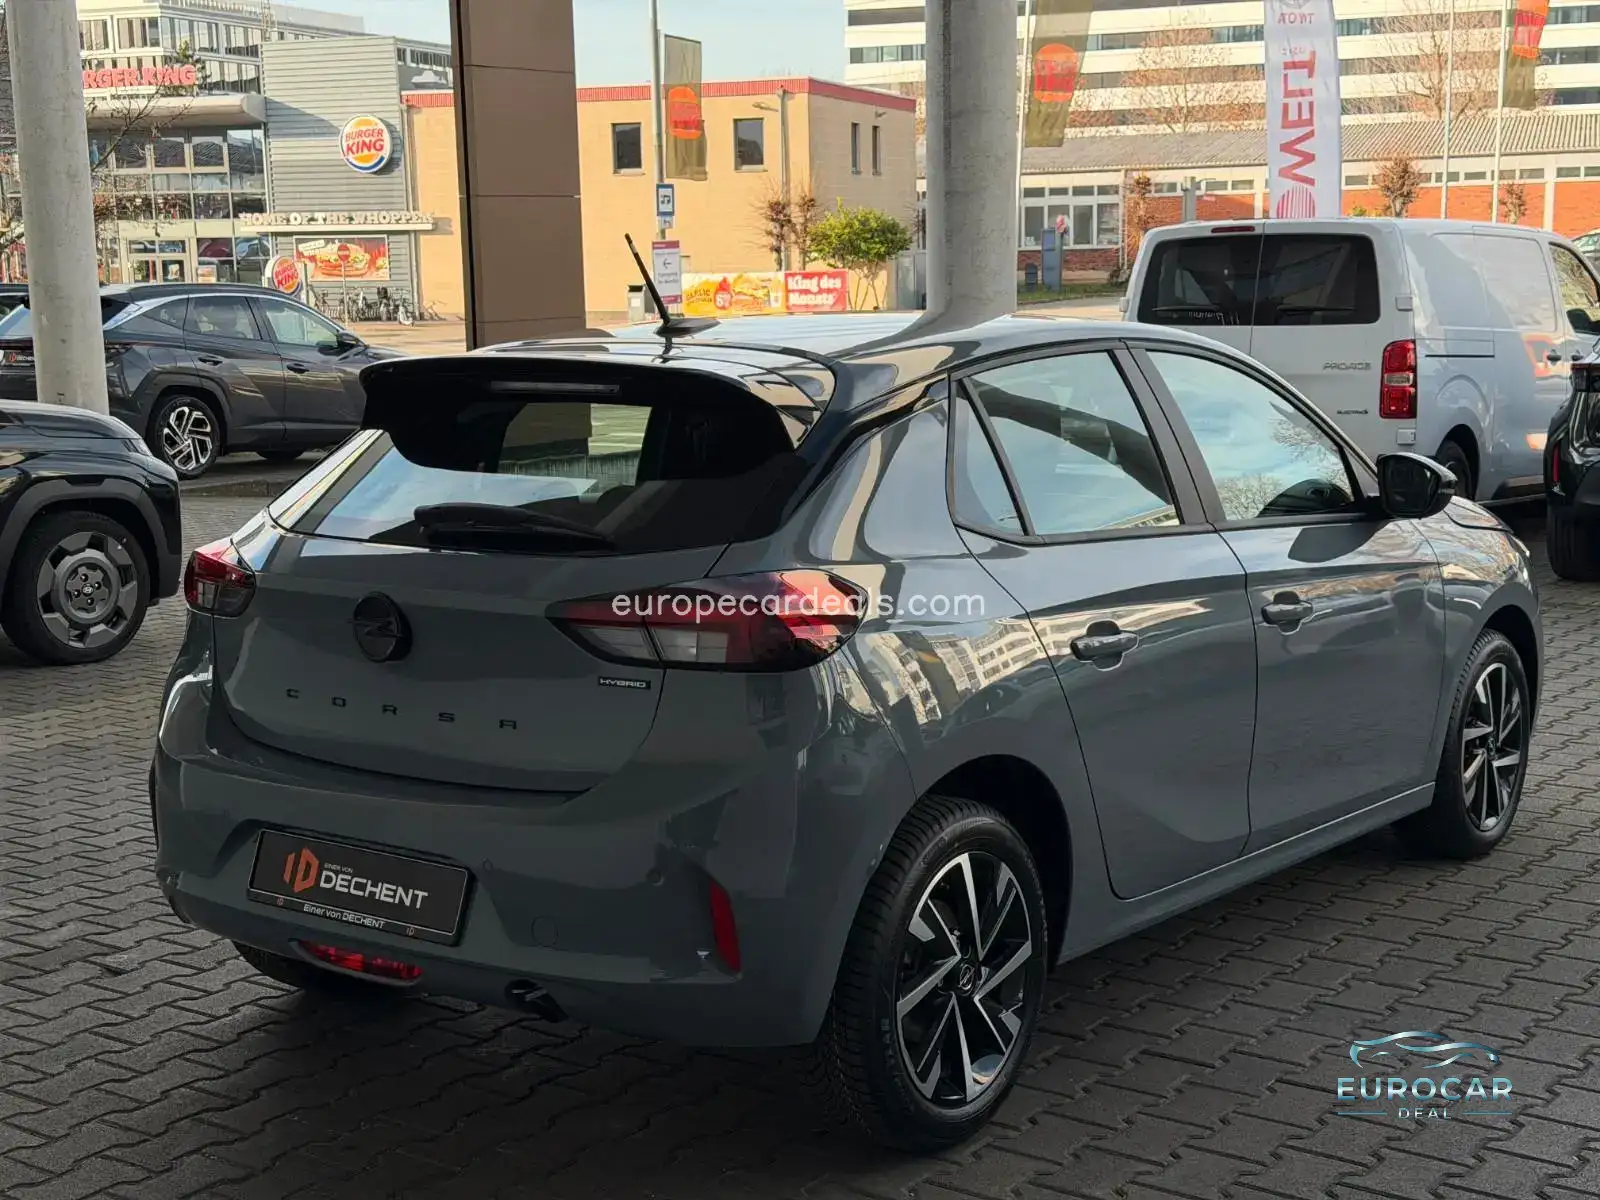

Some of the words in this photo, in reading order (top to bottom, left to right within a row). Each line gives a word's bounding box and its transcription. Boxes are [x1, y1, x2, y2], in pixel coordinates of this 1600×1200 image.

[82, 67, 139, 88] RGER
[141, 64, 197, 87] KING
[345, 128, 384, 141] BURGER
[346, 138, 385, 156] KING
[238, 212, 288, 226] HOME
[289, 212, 312, 226] OF
[314, 212, 349, 225] THE
[349, 211, 433, 225] WHOPPER
[787, 275, 819, 292] King
[820, 275, 842, 289] des
[600, 678, 647, 688] HYBRID
[286, 688, 517, 730] CORSA
[319, 870, 429, 909] DECHENT
[303, 903, 326, 916] Einer
[326, 909, 342, 920] von
[342, 912, 386, 929] DECHENT
